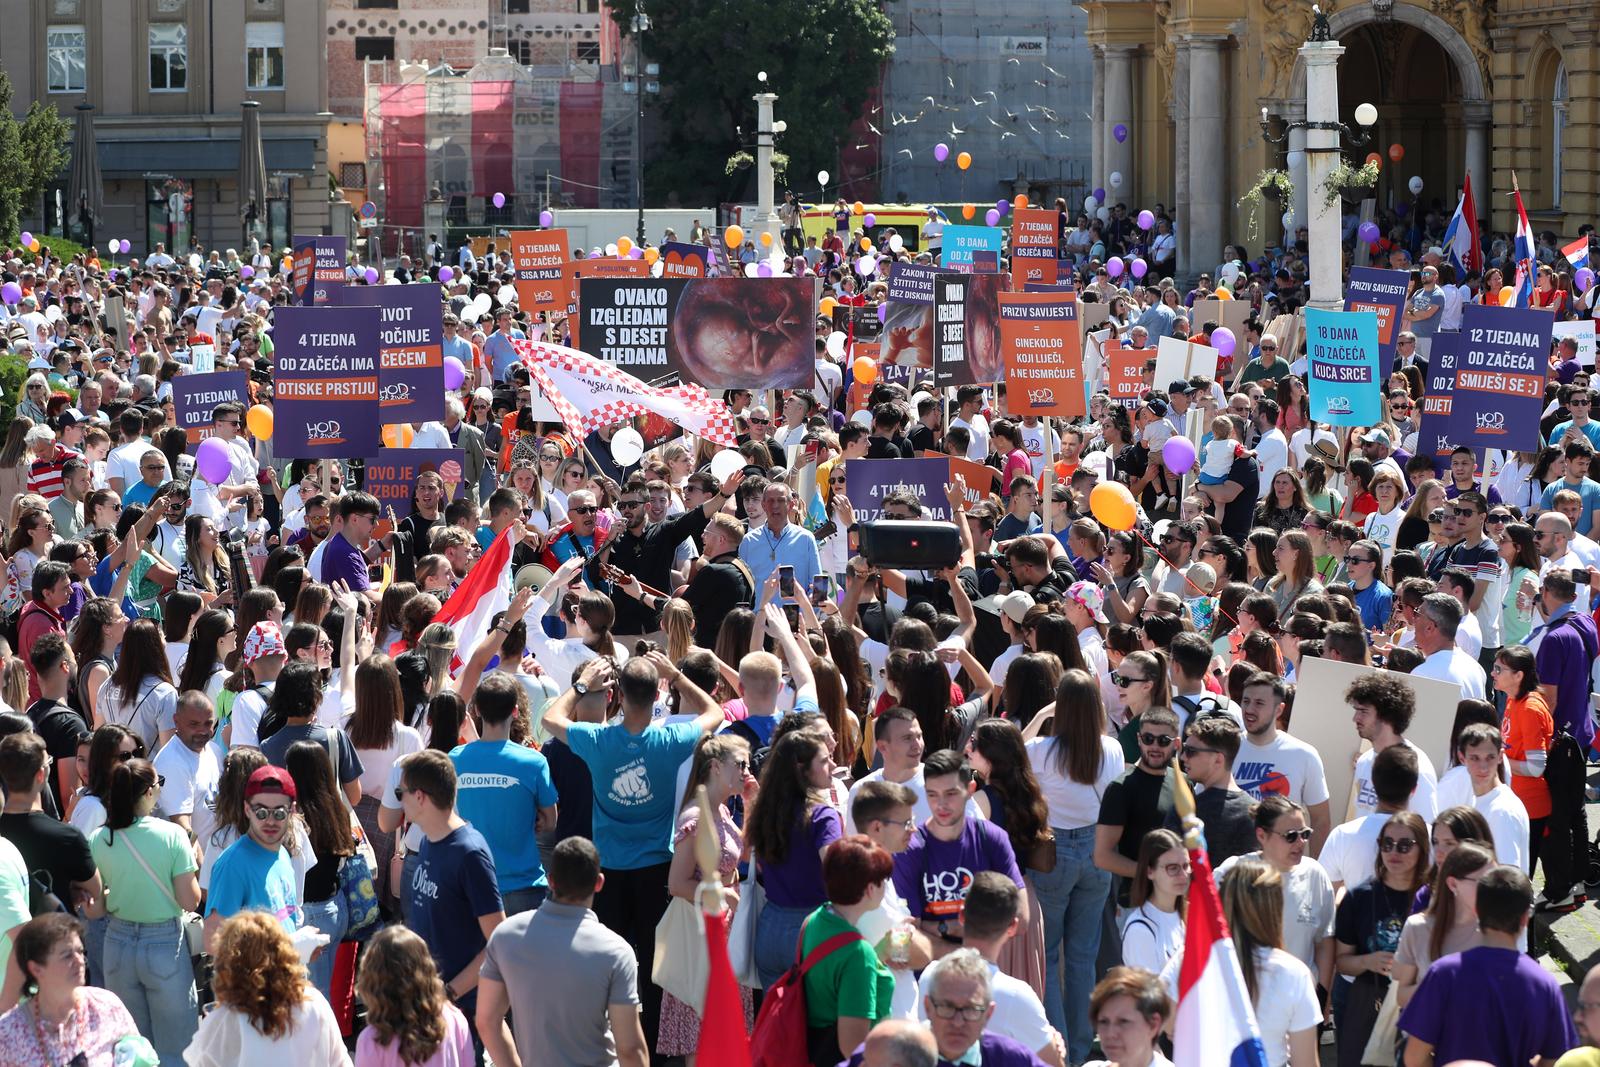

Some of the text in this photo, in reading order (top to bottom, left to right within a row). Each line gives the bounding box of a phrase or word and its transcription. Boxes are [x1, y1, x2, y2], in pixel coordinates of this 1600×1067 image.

[1020, 222, 1053, 232] 7 TJEDANA
[956, 237, 988, 248] 18 DANA
[1019, 233, 1053, 244] OD ZAČEĆA
[519, 243, 561, 254] 9 TJEDANA
[950, 250, 962, 260] OD
[1017, 246, 1054, 257] OSJEĆA BOL
[316, 258, 339, 268] AČEĆA
[520, 254, 563, 267] OD ZAČEĆA
[320, 269, 345, 280] ŠTUCA
[521, 268, 563, 280] SISA PALA
[675, 263, 698, 277] VOLIMO
[901, 268, 925, 279] ZAKON
[893, 276, 932, 290] ŠTITITI SVE
[1350, 280, 1406, 296] PRIZIV SAVIJESTI
[614, 288, 668, 306] OVAKO
[890, 289, 904, 298] BEZ
[945, 283, 964, 302] OVAKO
[590, 308, 668, 326] IZGLEDAM
[938, 303, 964, 322] IZGLEDAM
[1002, 306, 1073, 317] PRIZIV SAVIJESTI
[605, 328, 668, 345] S DESET
[947, 323, 964, 342] DESET
[1317, 325, 1359, 341] 18 DANA
[1470, 328, 1540, 348] 12 TJEDANA
[298, 333, 357, 347] 4 TJEDNA
[1015, 337, 1063, 348] GINEKOLOG
[380, 349, 427, 367] ČEĆEM
[941, 343, 964, 362] TJEDANA
[1016, 351, 1065, 365] KOJI LIJEČI,
[1314, 344, 1366, 361] OD ZAČEĆA
[279, 354, 375, 371] OD ZAČEĆA IMA
[1441, 355, 1455, 369] 52
[1467, 350, 1535, 371] OD ZAČEĆA
[886, 365, 903, 380] ZA
[1010, 366, 1076, 379] A NE USMRĆUJE
[1123, 366, 1136, 377] 52
[1314, 363, 1367, 381] KUCA SRCE
[278, 381, 376, 396] OTISKE PRSTIJU
[379, 382, 410, 396] HOD
[1118, 382, 1131, 393] OD
[1433, 376, 1455, 391] OD Z
[1459, 373, 1506, 391] SMIJEŠI
[1508, 377, 1526, 392] SE
[184, 389, 239, 406] 7 TJEDANA
[1027, 387, 1053, 400] HOD
[186, 411, 200, 424] OD
[1475, 411, 1505, 424] HOD
[306, 420, 341, 434] HOD
[319, 431, 342, 440] ŽIVOT
[368, 466, 414, 481] OVO JE
[368, 483, 409, 498] IZBOR
[869, 485, 879, 498] 4
[930, 507, 946, 521] MA
[1235, 762, 1276, 780] NIKE
[460, 776, 509, 786] VOLONTER
[412, 864, 439, 899] Oliver
[923, 866, 975, 896] HOD
